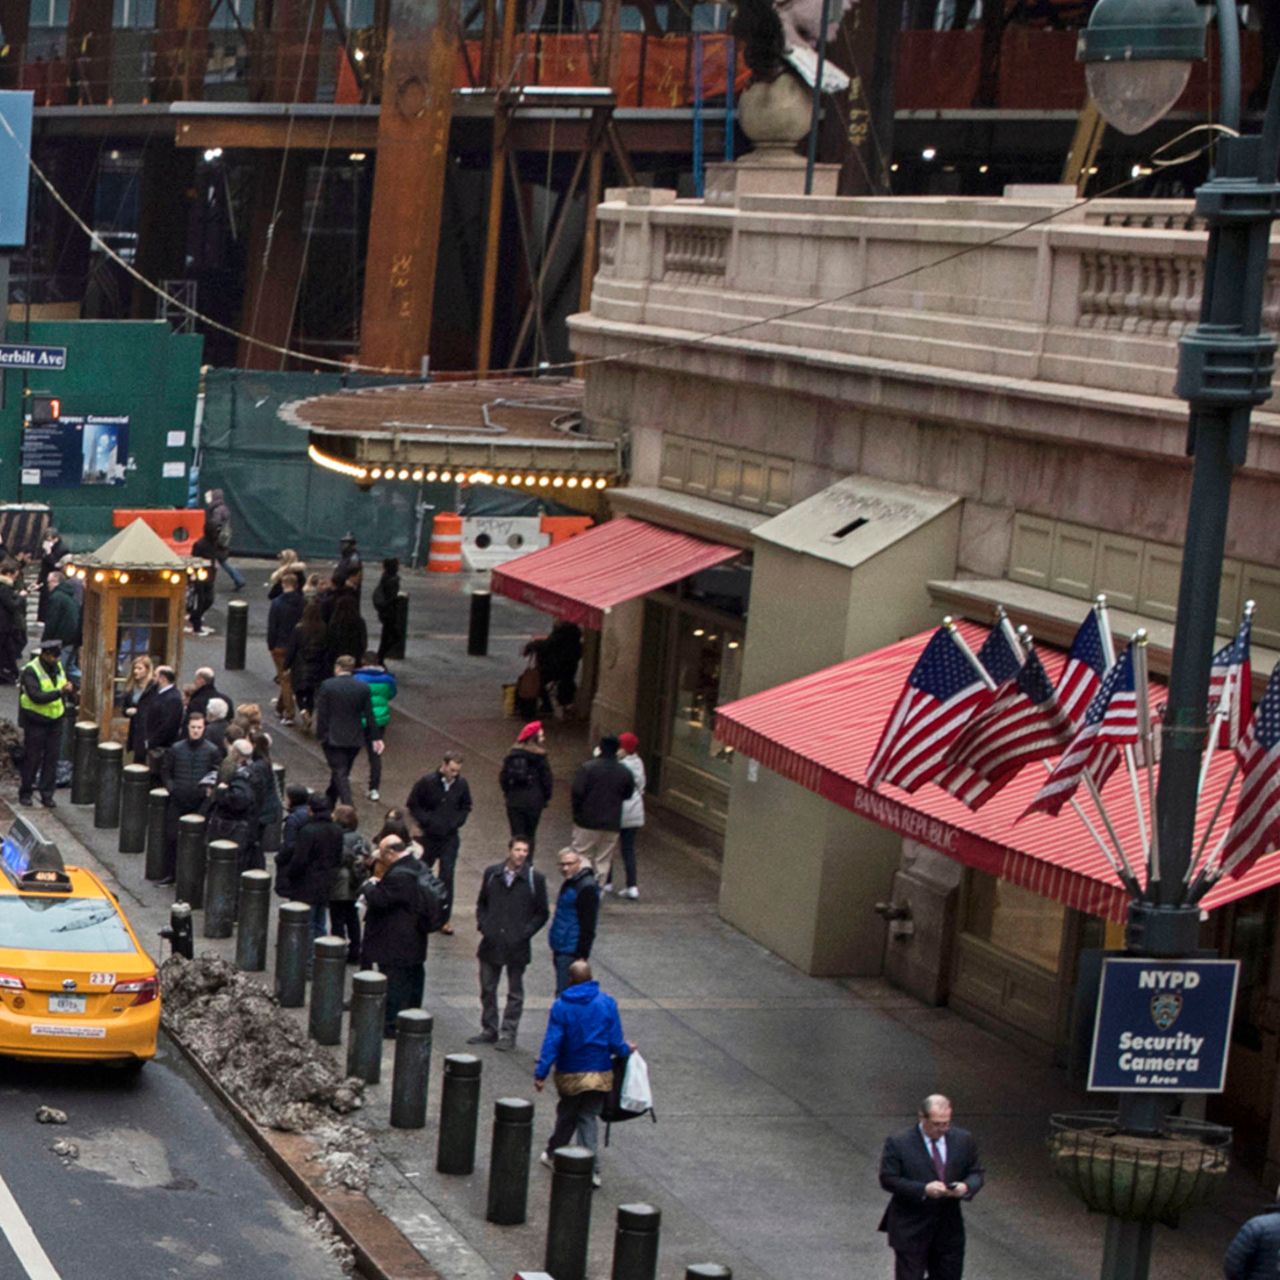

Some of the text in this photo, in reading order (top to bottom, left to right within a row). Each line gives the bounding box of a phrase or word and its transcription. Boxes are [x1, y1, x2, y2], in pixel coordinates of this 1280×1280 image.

[37, 351, 63, 365] Ave
[854, 788, 960, 852] BANANA REPUBLIC
[1138, 970, 1201, 989] NYPD
[1118, 1031, 1205, 1056] Security
[1118, 1052, 1200, 1072] Camera
[1135, 1075, 1179, 1085] In Area
